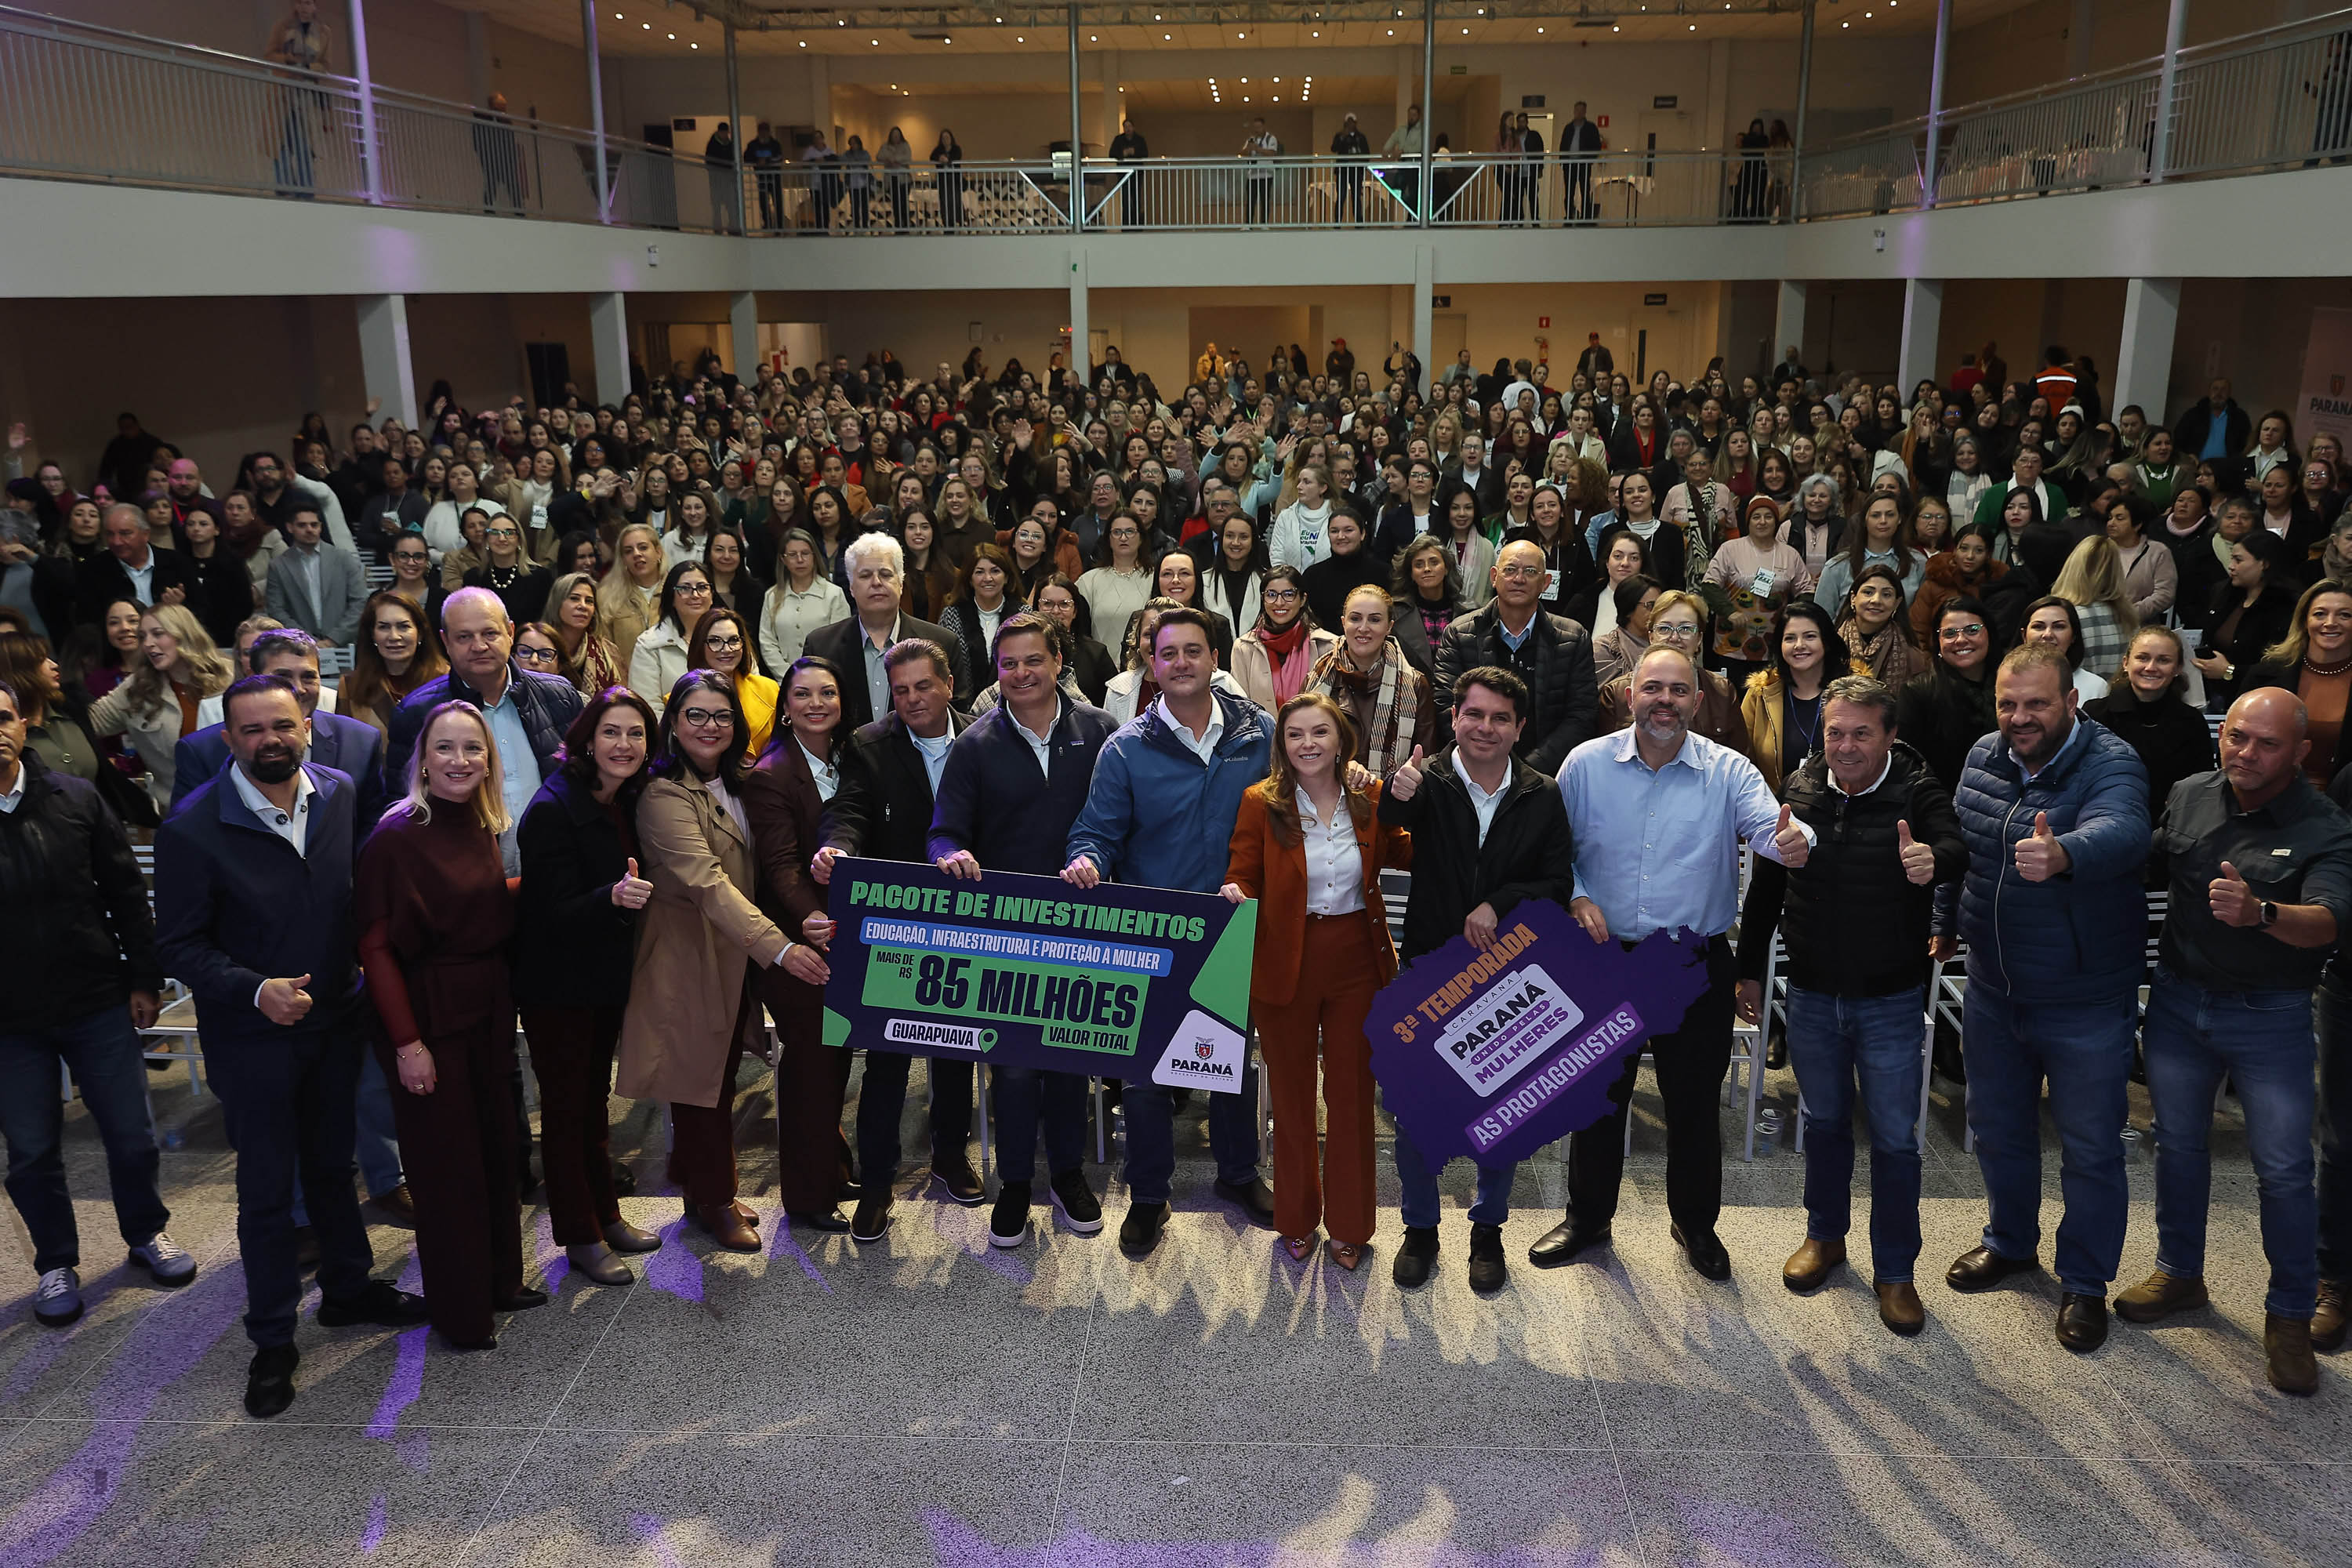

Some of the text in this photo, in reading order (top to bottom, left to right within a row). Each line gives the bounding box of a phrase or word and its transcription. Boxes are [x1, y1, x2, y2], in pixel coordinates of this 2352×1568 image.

[850, 881, 1206, 942] PACOTE DE INVESTIMENTOS
[866, 922, 1161, 971] EDUCAÇÃO, INFRAESTRUTURA E PROTEÇÃO À MULHER
[877, 951, 915, 966] MAIS DE
[898, 967, 912, 979] R$
[915, 954, 1139, 1029] 85 MILHÕES
[1392, 922, 1539, 1044] 3ª TEMPORADA
[1451, 978, 1514, 1029] CARAVANA
[891, 1022, 974, 1047] GUARAPUAVA
[1049, 1026, 1130, 1051] VALOR TOTAL
[1450, 980, 1547, 1061] PARANÁ
[1474, 1004, 1546, 1062] UNIDO PELAS
[1474, 1007, 1569, 1085] MULHERES
[1171, 1058, 1233, 1076] PARANÁ
[1473, 1011, 1636, 1146] AS PROTAGONISTAS
